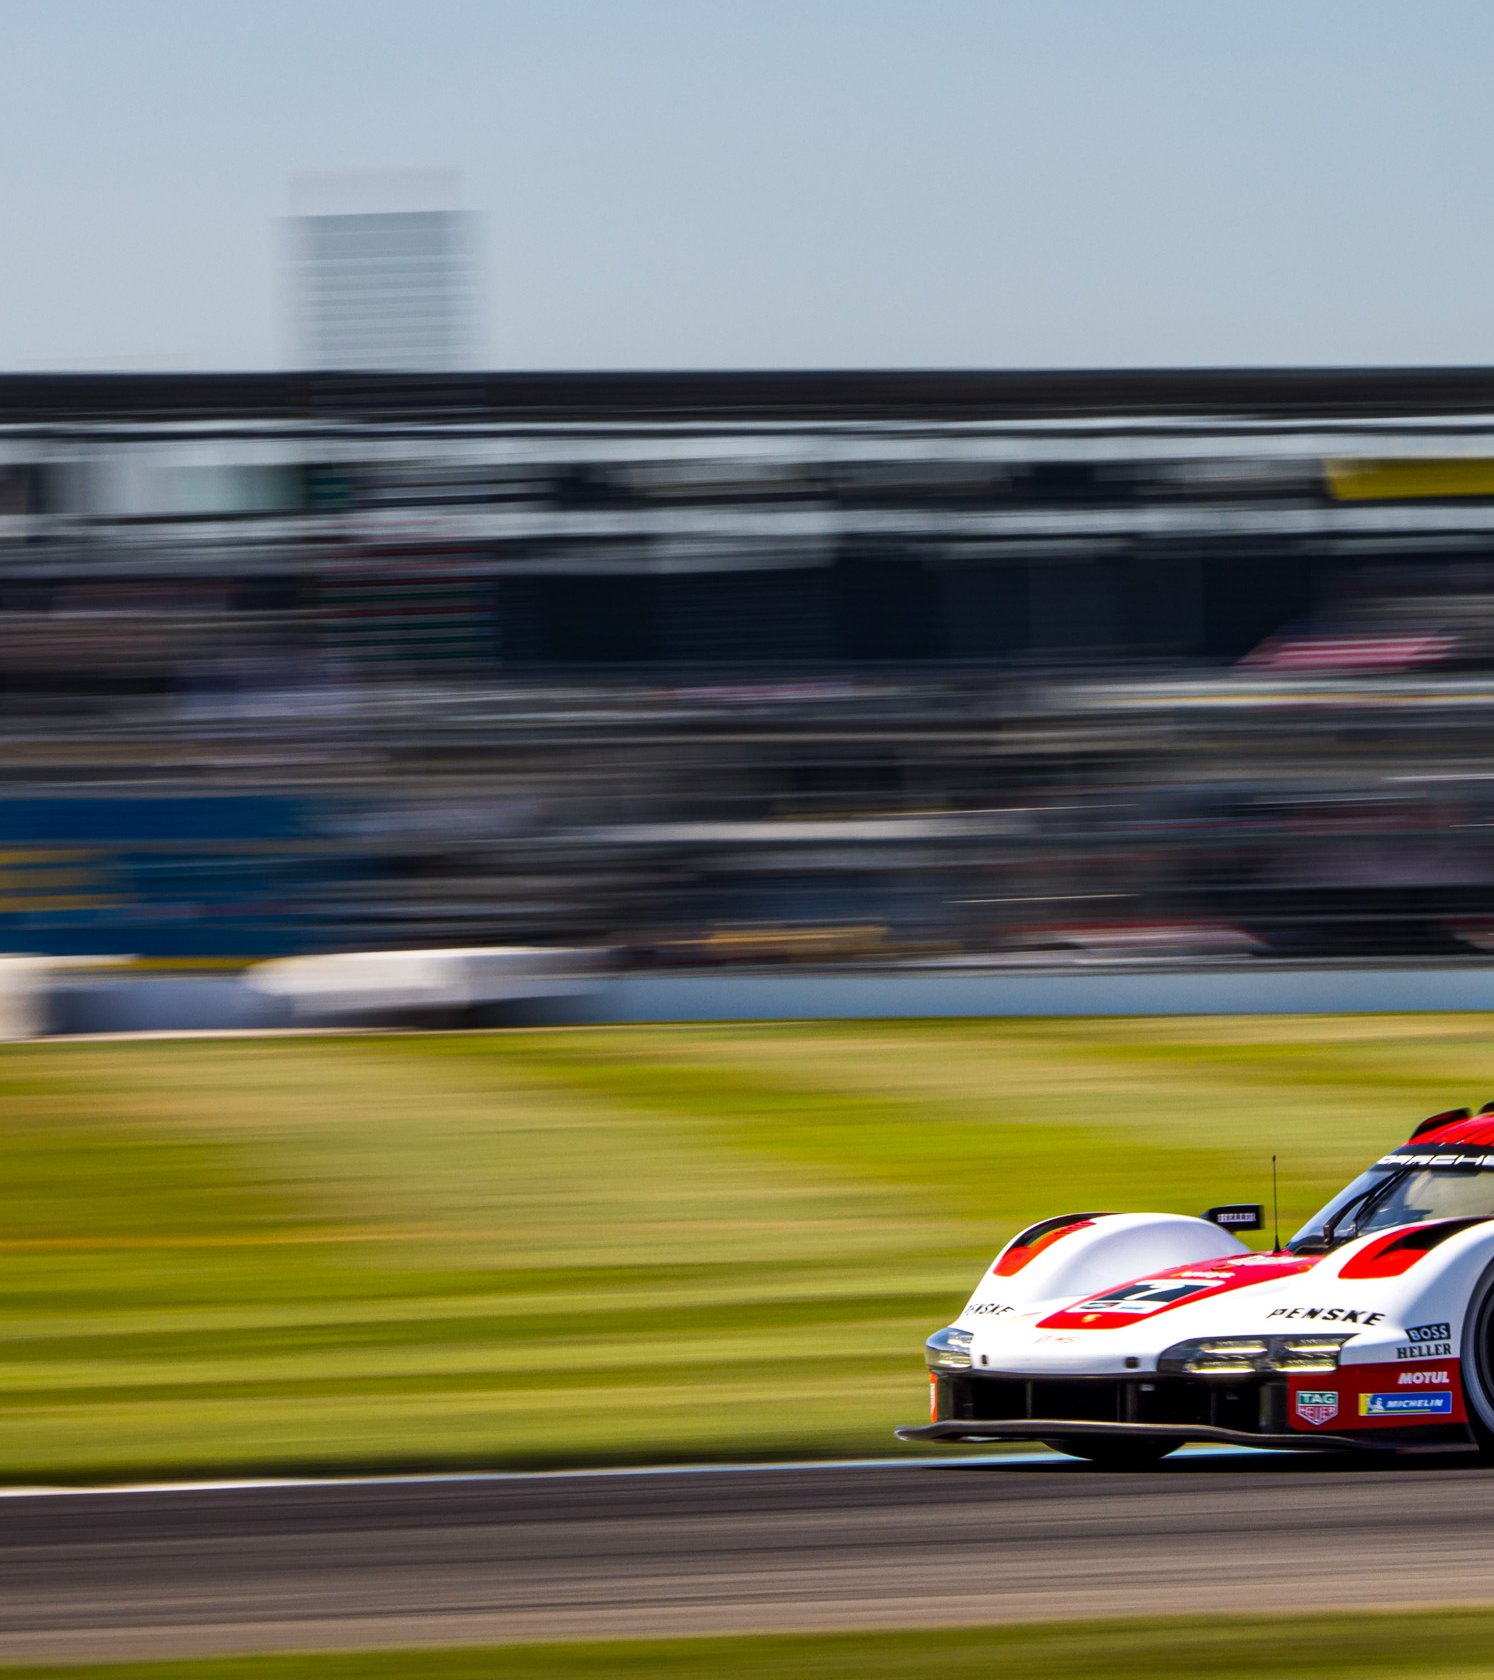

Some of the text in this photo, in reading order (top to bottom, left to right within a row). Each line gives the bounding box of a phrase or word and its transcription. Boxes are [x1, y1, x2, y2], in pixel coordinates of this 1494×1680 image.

[1267, 1308, 1385, 1326] PENSKE
[1408, 1325, 1449, 1341] BOSS
[1397, 1344, 1452, 1359] HELLER
[1398, 1372, 1449, 1384] MOTUL
[1300, 1393, 1335, 1404] TAG
[1387, 1400, 1443, 1408] MICHELIN
